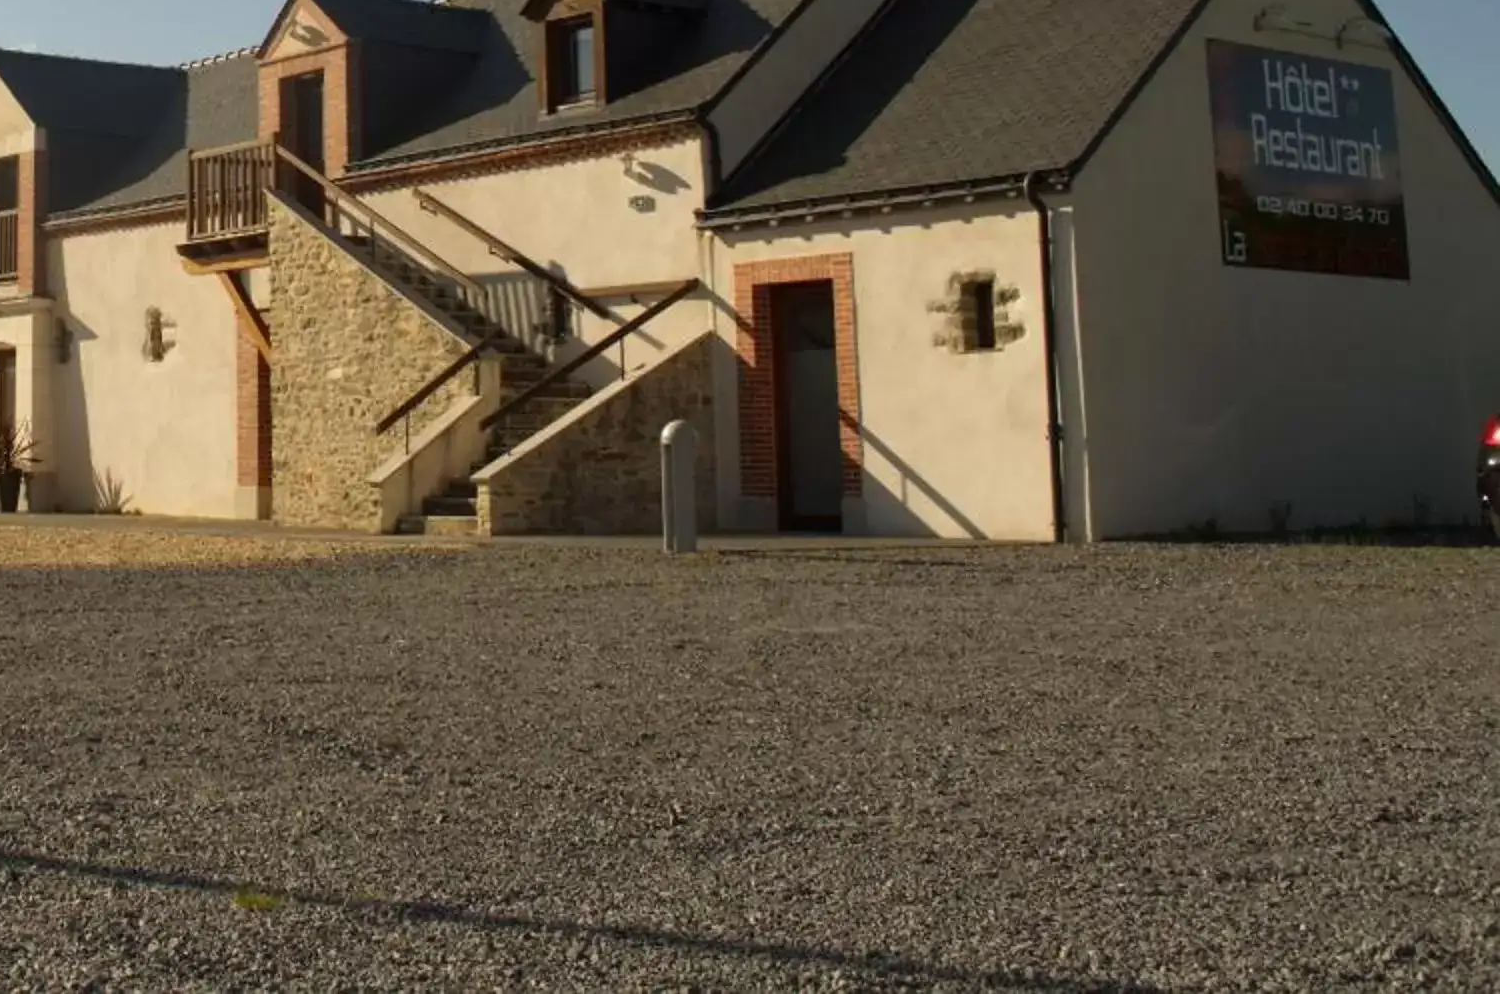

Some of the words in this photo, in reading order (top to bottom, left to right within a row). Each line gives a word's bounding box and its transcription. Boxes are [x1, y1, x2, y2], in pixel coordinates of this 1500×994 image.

[1262, 58, 1340, 118] Hôtel
[1251, 112, 1384, 180] Restaurant
[1257, 195, 1282, 214] 02
[1287, 198, 1310, 217] 40
[1223, 219, 1247, 262] La
